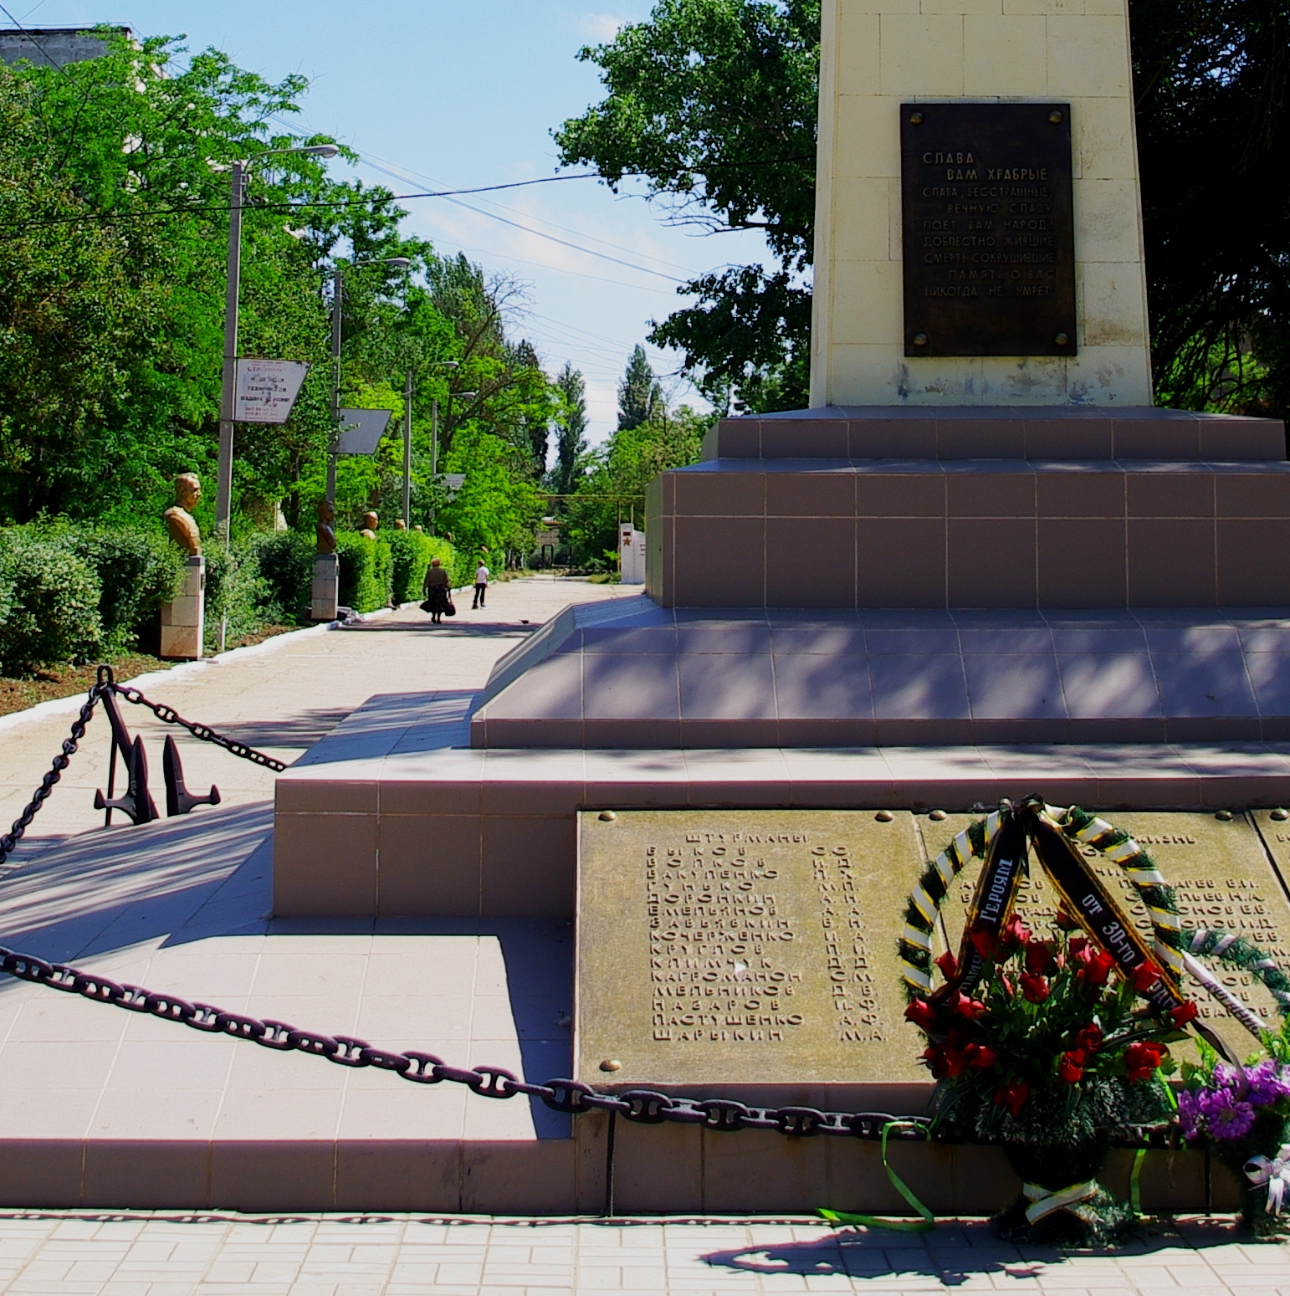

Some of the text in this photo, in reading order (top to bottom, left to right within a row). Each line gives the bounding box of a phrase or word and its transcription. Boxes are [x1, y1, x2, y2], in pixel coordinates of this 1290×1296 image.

[922, 152, 974, 164] СЛАВА
[947, 168, 977, 181] ВАМ
[947, 203, 1052, 214] ВЕЧНУЮ СЛАВУ
[923, 220, 957, 230] ПОЕТ
[968, 220, 994, 229] ВАМ
[924, 237, 995, 248] ДОБЛЕСТНО
[924, 253, 967, 263] СМЕРТЬ
[948, 269, 1055, 280] ПАМЯТЬ О ВАС
[924, 286, 978, 297] НИКОГДА
[988, 286, 1002, 295] НЕ
[686, 833, 808, 843] ШТУРМАНЫ
[652, 999, 781, 1011] НАЗАРОВ
[652, 1014, 804, 1026] ПАСТУШЕНКО
[652, 1030, 784, 1041] ШАРЫКИН
